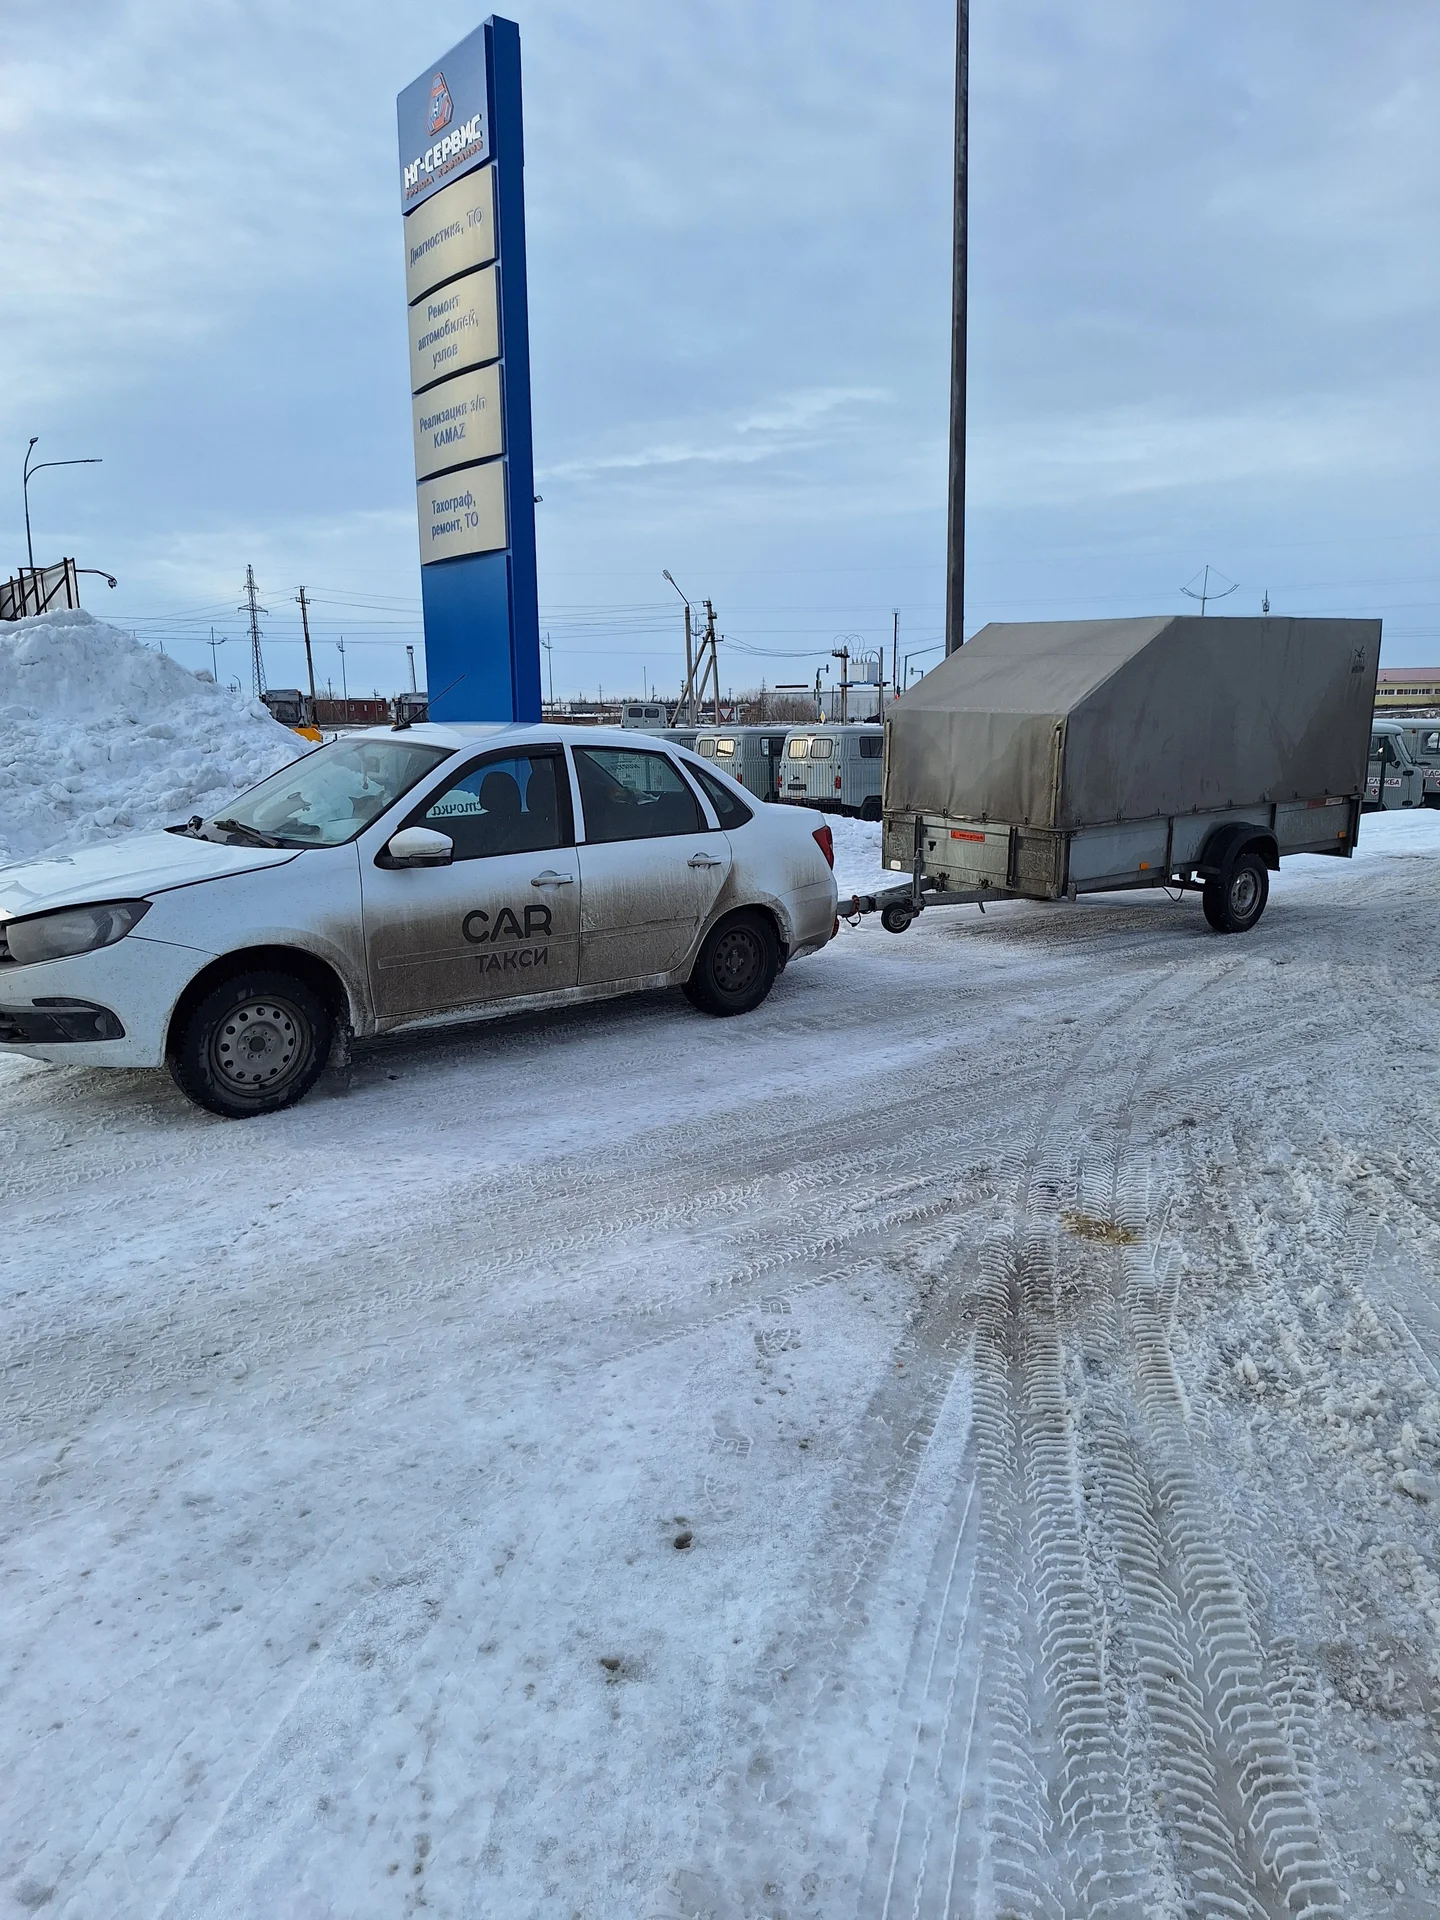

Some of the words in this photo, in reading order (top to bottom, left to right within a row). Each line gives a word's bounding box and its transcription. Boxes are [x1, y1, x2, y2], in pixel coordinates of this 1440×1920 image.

[404, 113, 482, 189] НГ-СЕРВИС
[410, 220, 464, 268] Диагностика,
[466, 207, 483, 229] ТО
[427, 294, 460, 322] Ремонт
[418, 308, 479, 351] автомобилей,
[432, 343, 458, 370] узлов
[419, 402, 467, 433] Реализация
[432, 490, 476, 515] Тахограф,
[431, 518, 463, 540] ремонт,
[464, 511, 479, 528] ТО
[462, 904, 552, 943] CAR
[475, 947, 548, 973] ТАКСИ
